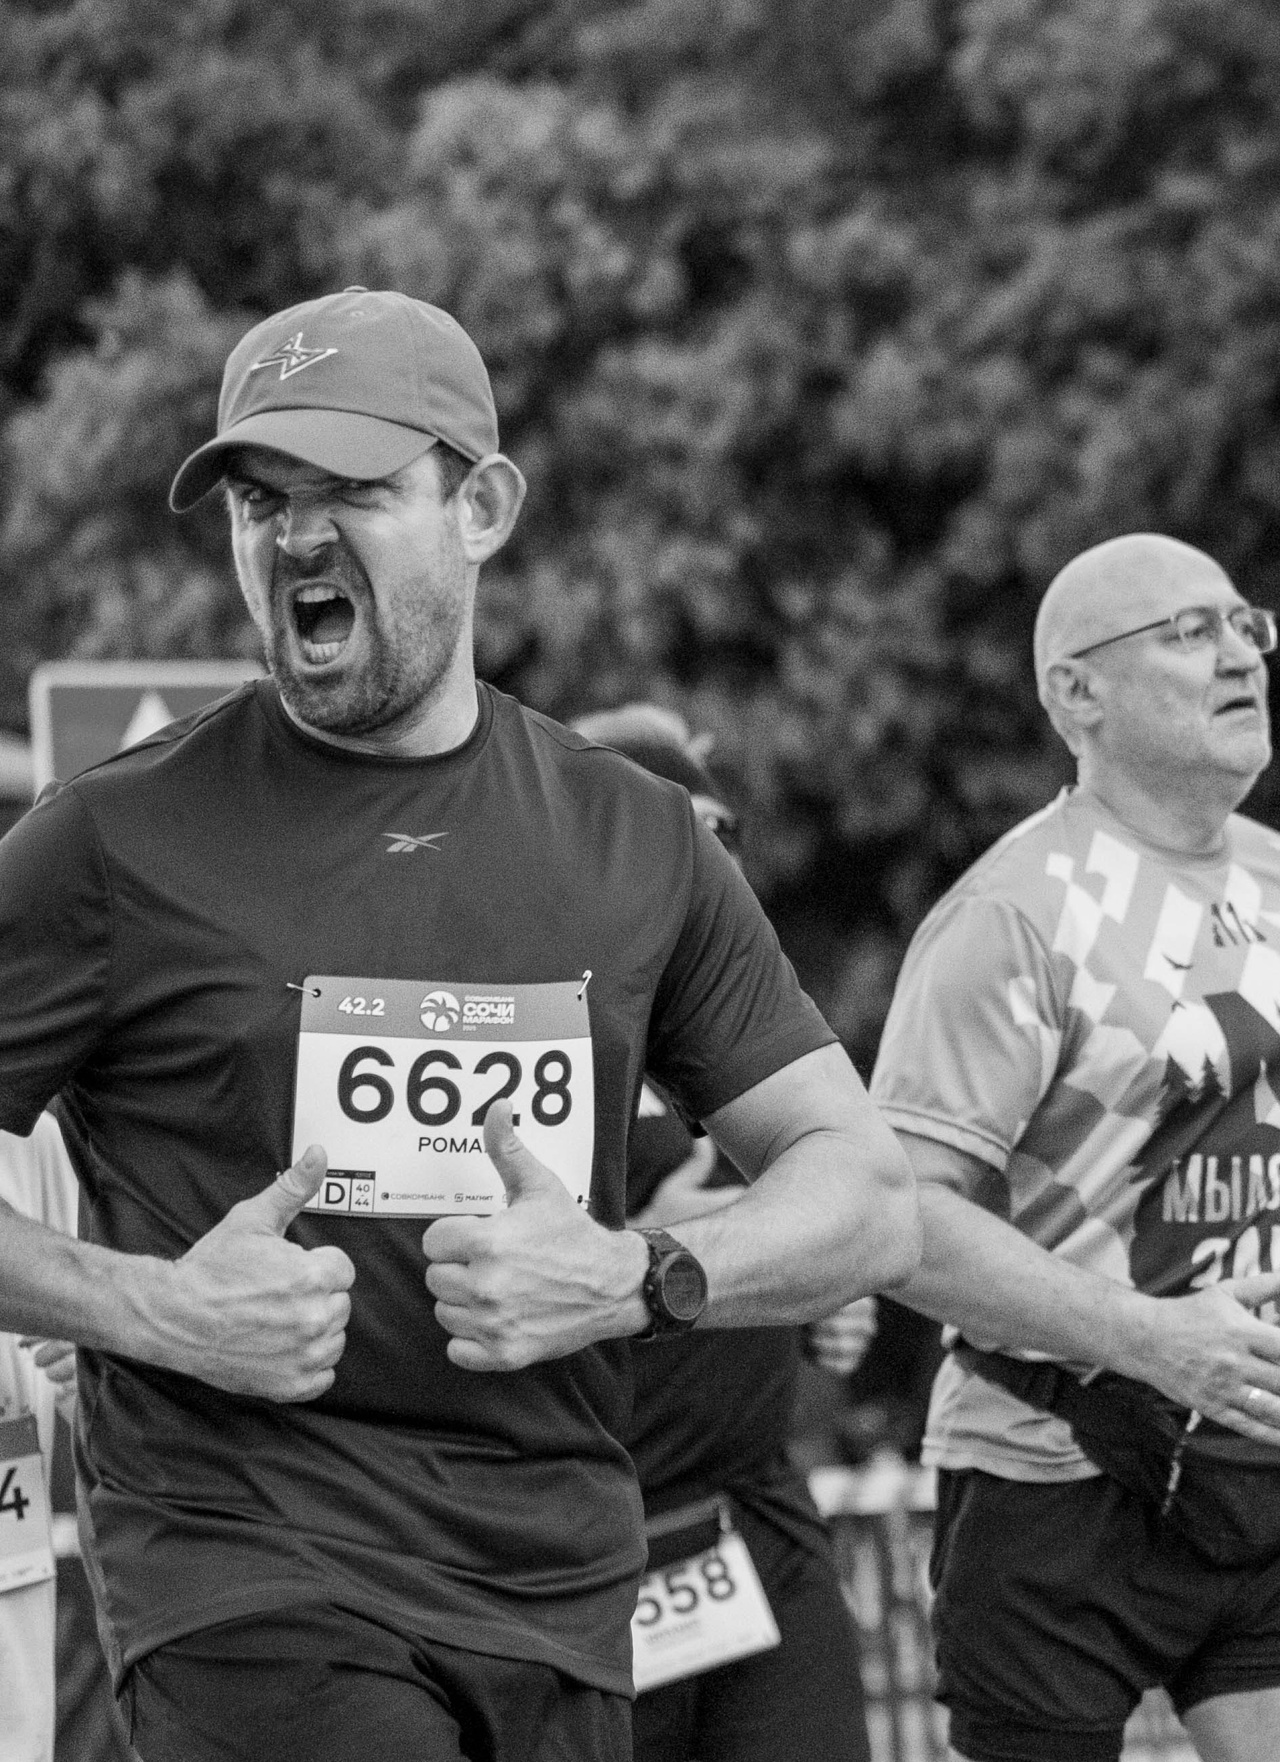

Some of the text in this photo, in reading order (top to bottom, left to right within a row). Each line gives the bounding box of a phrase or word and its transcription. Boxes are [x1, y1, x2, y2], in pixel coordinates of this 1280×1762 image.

[338, 997, 386, 1016] 42.2
[462, 1002, 515, 1017] СОЧИ
[462, 1015, 515, 1025] МАРАФОН
[337, 1045, 573, 1127] 6628
[418, 1137, 488, 1153] РОМА
[324, 1182, 346, 1205] D
